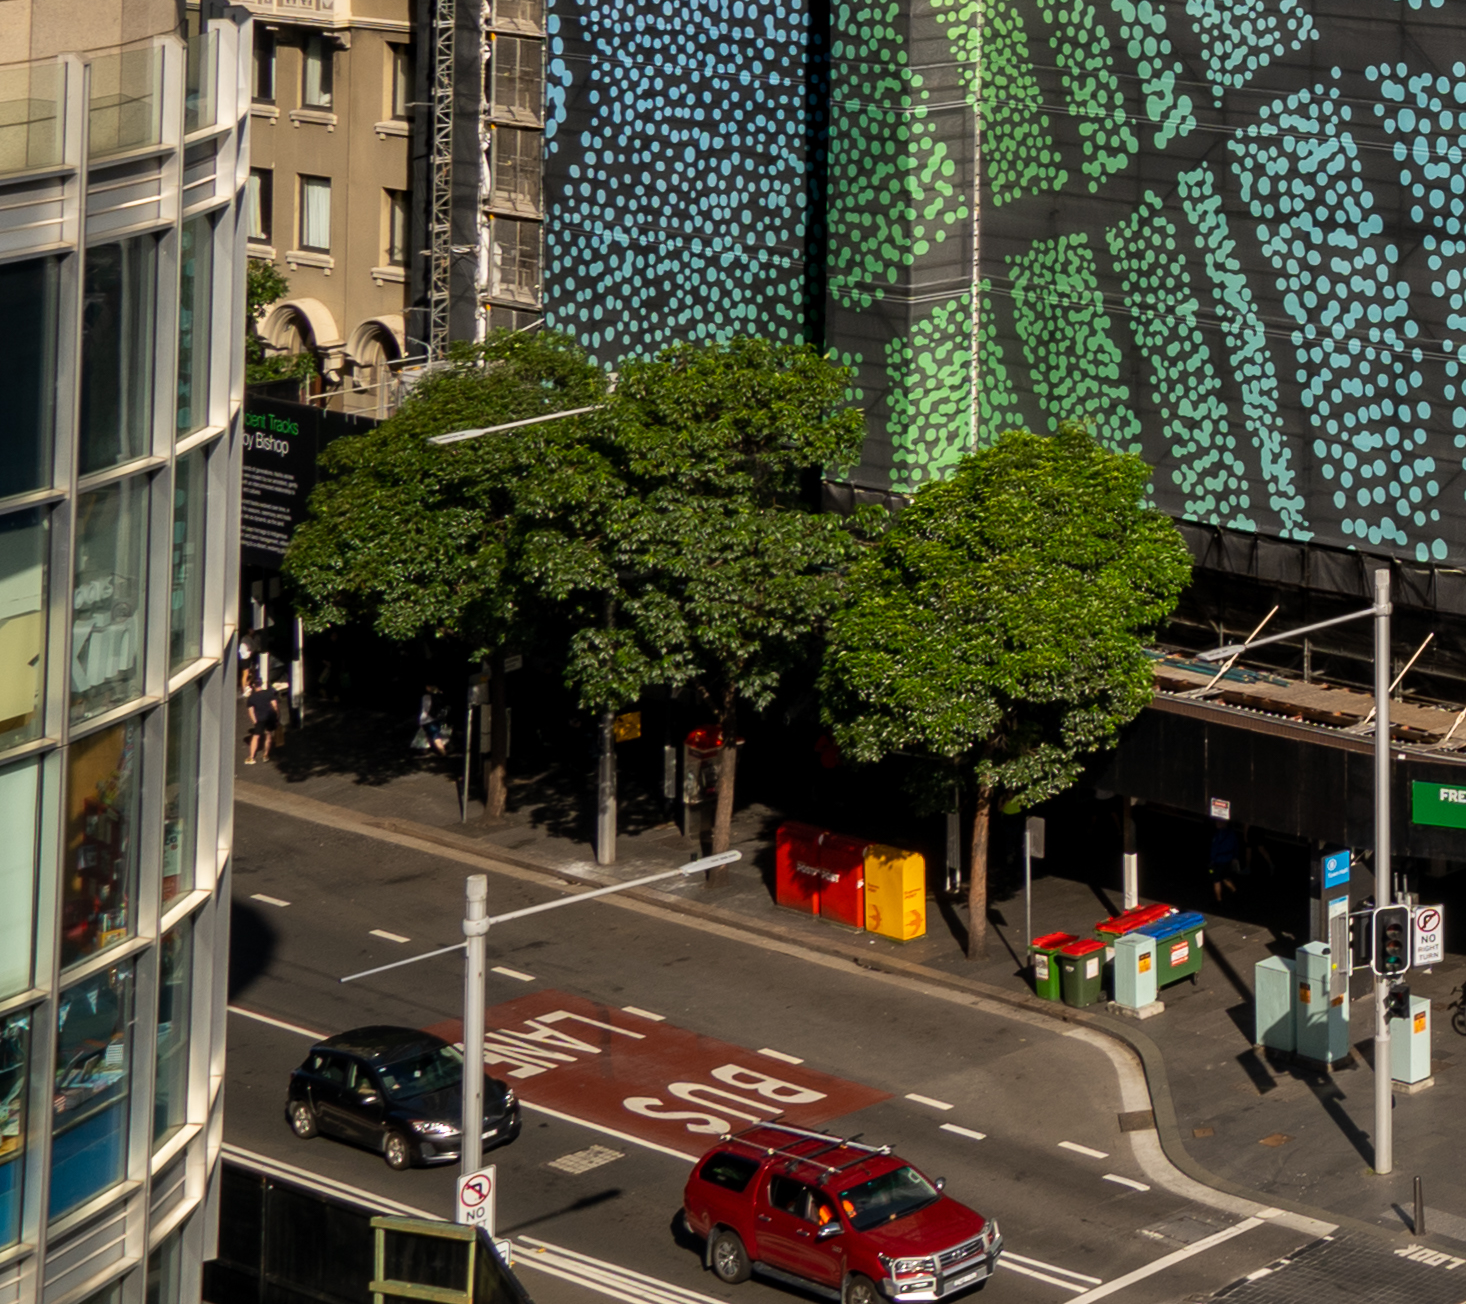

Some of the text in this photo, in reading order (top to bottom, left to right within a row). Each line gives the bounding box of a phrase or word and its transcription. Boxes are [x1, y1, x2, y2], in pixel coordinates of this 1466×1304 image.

[244, 411, 299, 436] cient Tracks
[255, 431, 290, 458] Bishop
[1421, 934, 1436, 944] NO
[1418, 944, 1439, 953] RIGHT
[1419, 952, 1439, 960] TURN
[622, 1063, 828, 1135] BUS
[466, 1206, 485, 1222] NO
